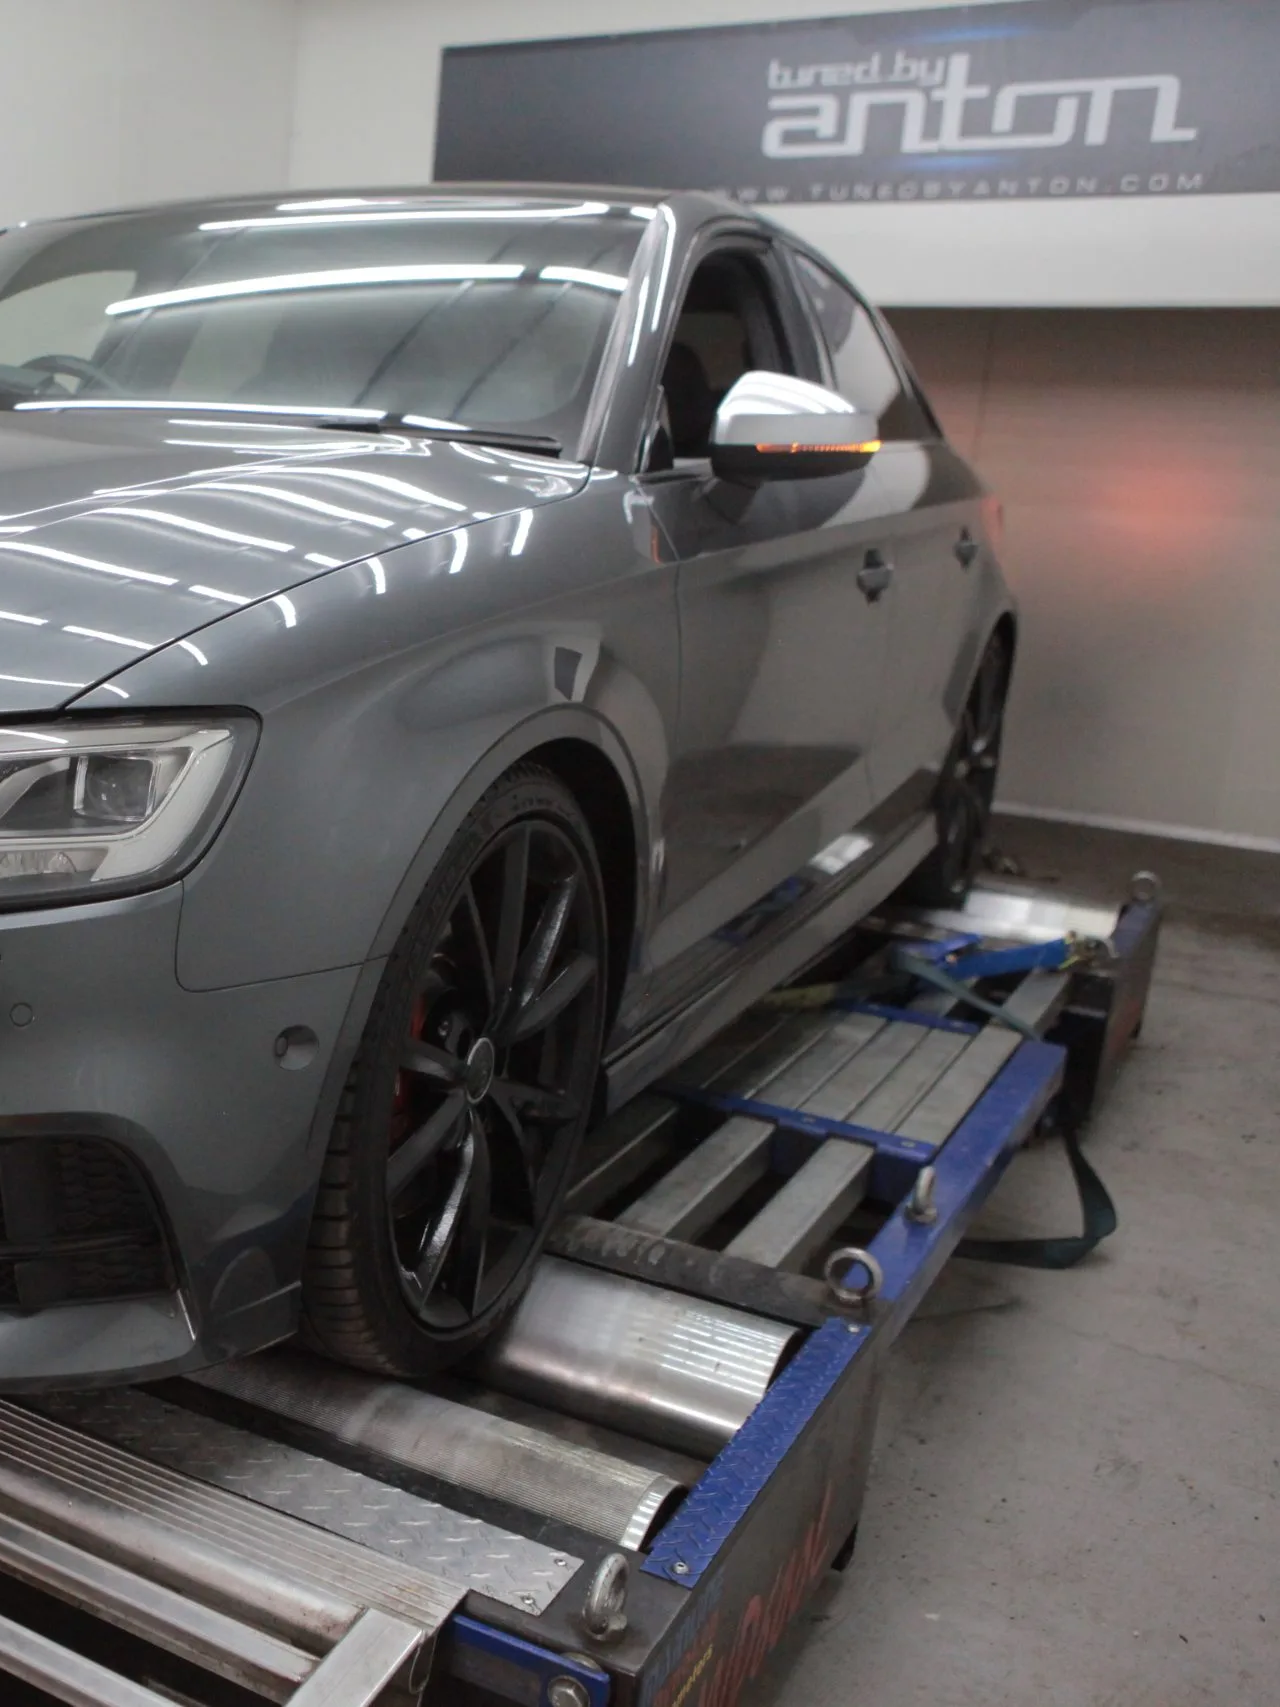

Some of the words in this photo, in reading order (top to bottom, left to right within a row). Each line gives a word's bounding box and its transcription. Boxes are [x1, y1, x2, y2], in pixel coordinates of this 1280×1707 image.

[761, 52, 1199, 159] anton
[767, 51, 885, 90] tuned
[887, 49, 947, 87] by
